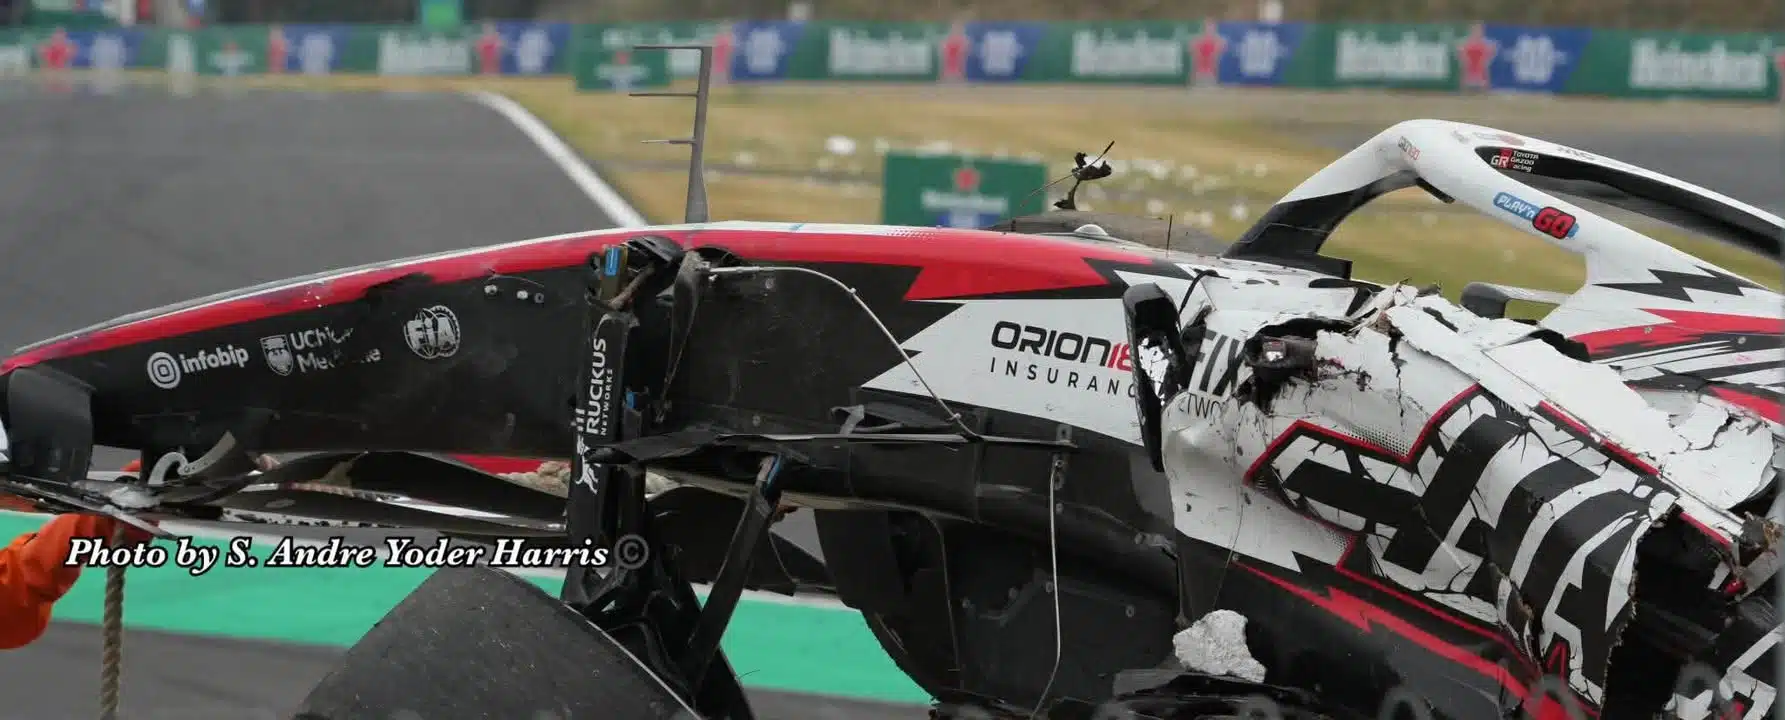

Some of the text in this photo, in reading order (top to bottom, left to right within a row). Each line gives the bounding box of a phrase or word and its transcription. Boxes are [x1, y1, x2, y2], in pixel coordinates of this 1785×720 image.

[1490, 155, 1510, 169] GR
[1510, 164, 1533, 173] acing
[1534, 207, 1575, 238] GO
[181, 344, 249, 374] infobip
[990, 320, 1133, 373] ORION18
[586, 338, 607, 435] RUCKUS
